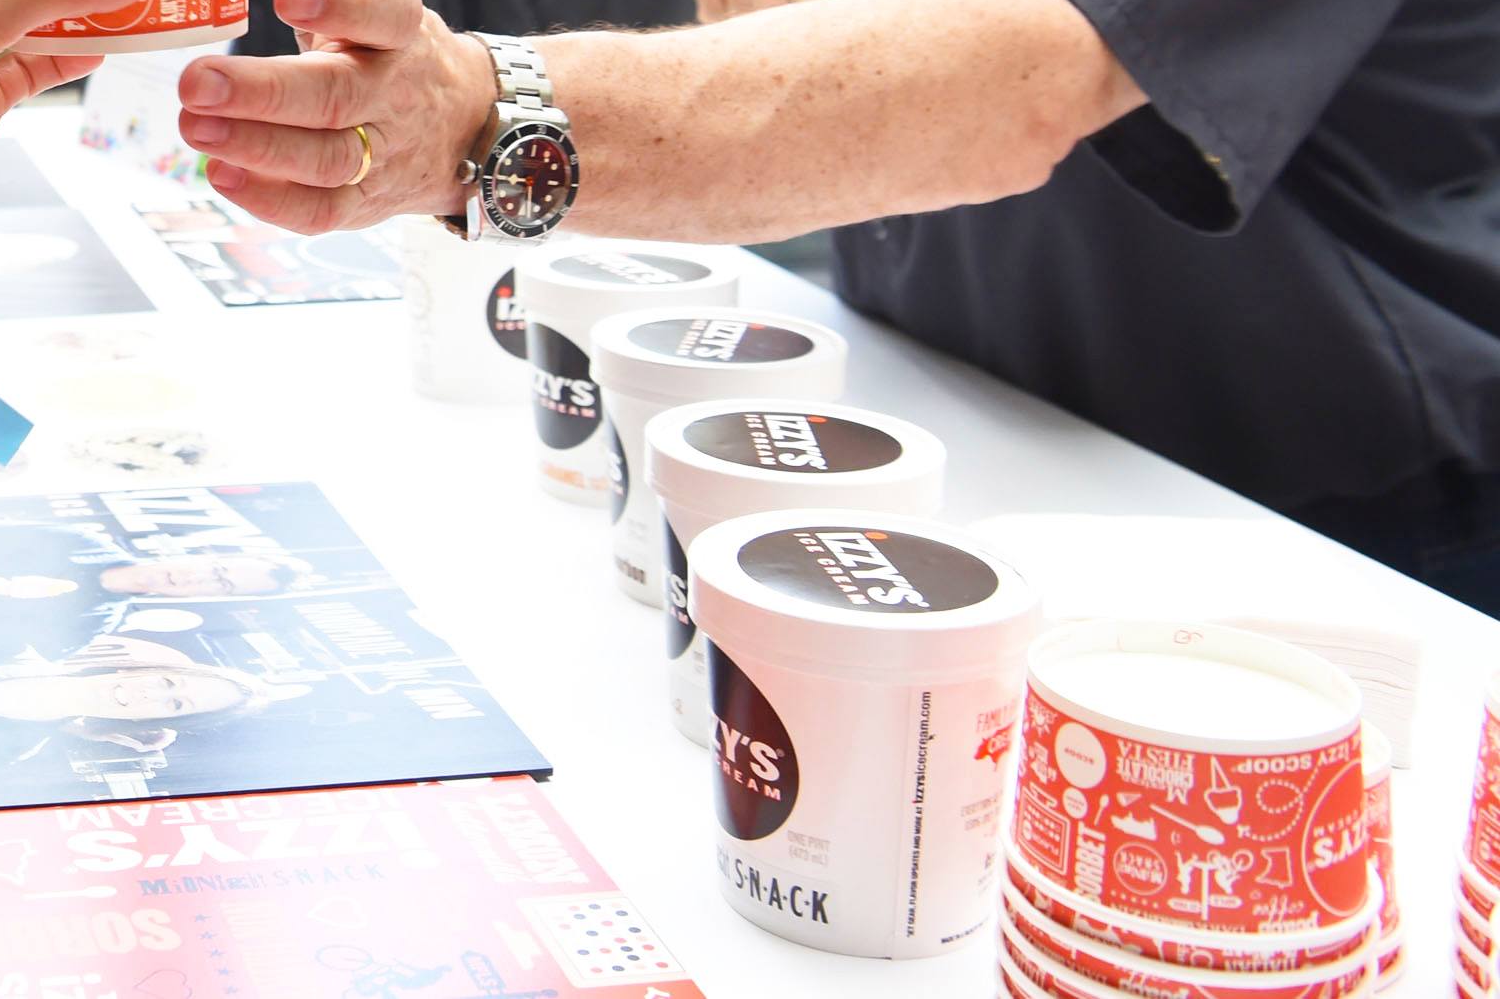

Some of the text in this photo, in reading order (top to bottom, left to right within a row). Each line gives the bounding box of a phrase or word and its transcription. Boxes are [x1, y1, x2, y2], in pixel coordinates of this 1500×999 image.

[744, 414, 777, 466] ICE CREAM
[793, 533, 870, 605] ICE CREAM
[1116, 739, 1194, 773] FIESTA
[1237, 755, 1312, 773] SCOOP
[1115, 757, 1193, 789] CHOCOLATE
[1252, 894, 1304, 923] coffee
